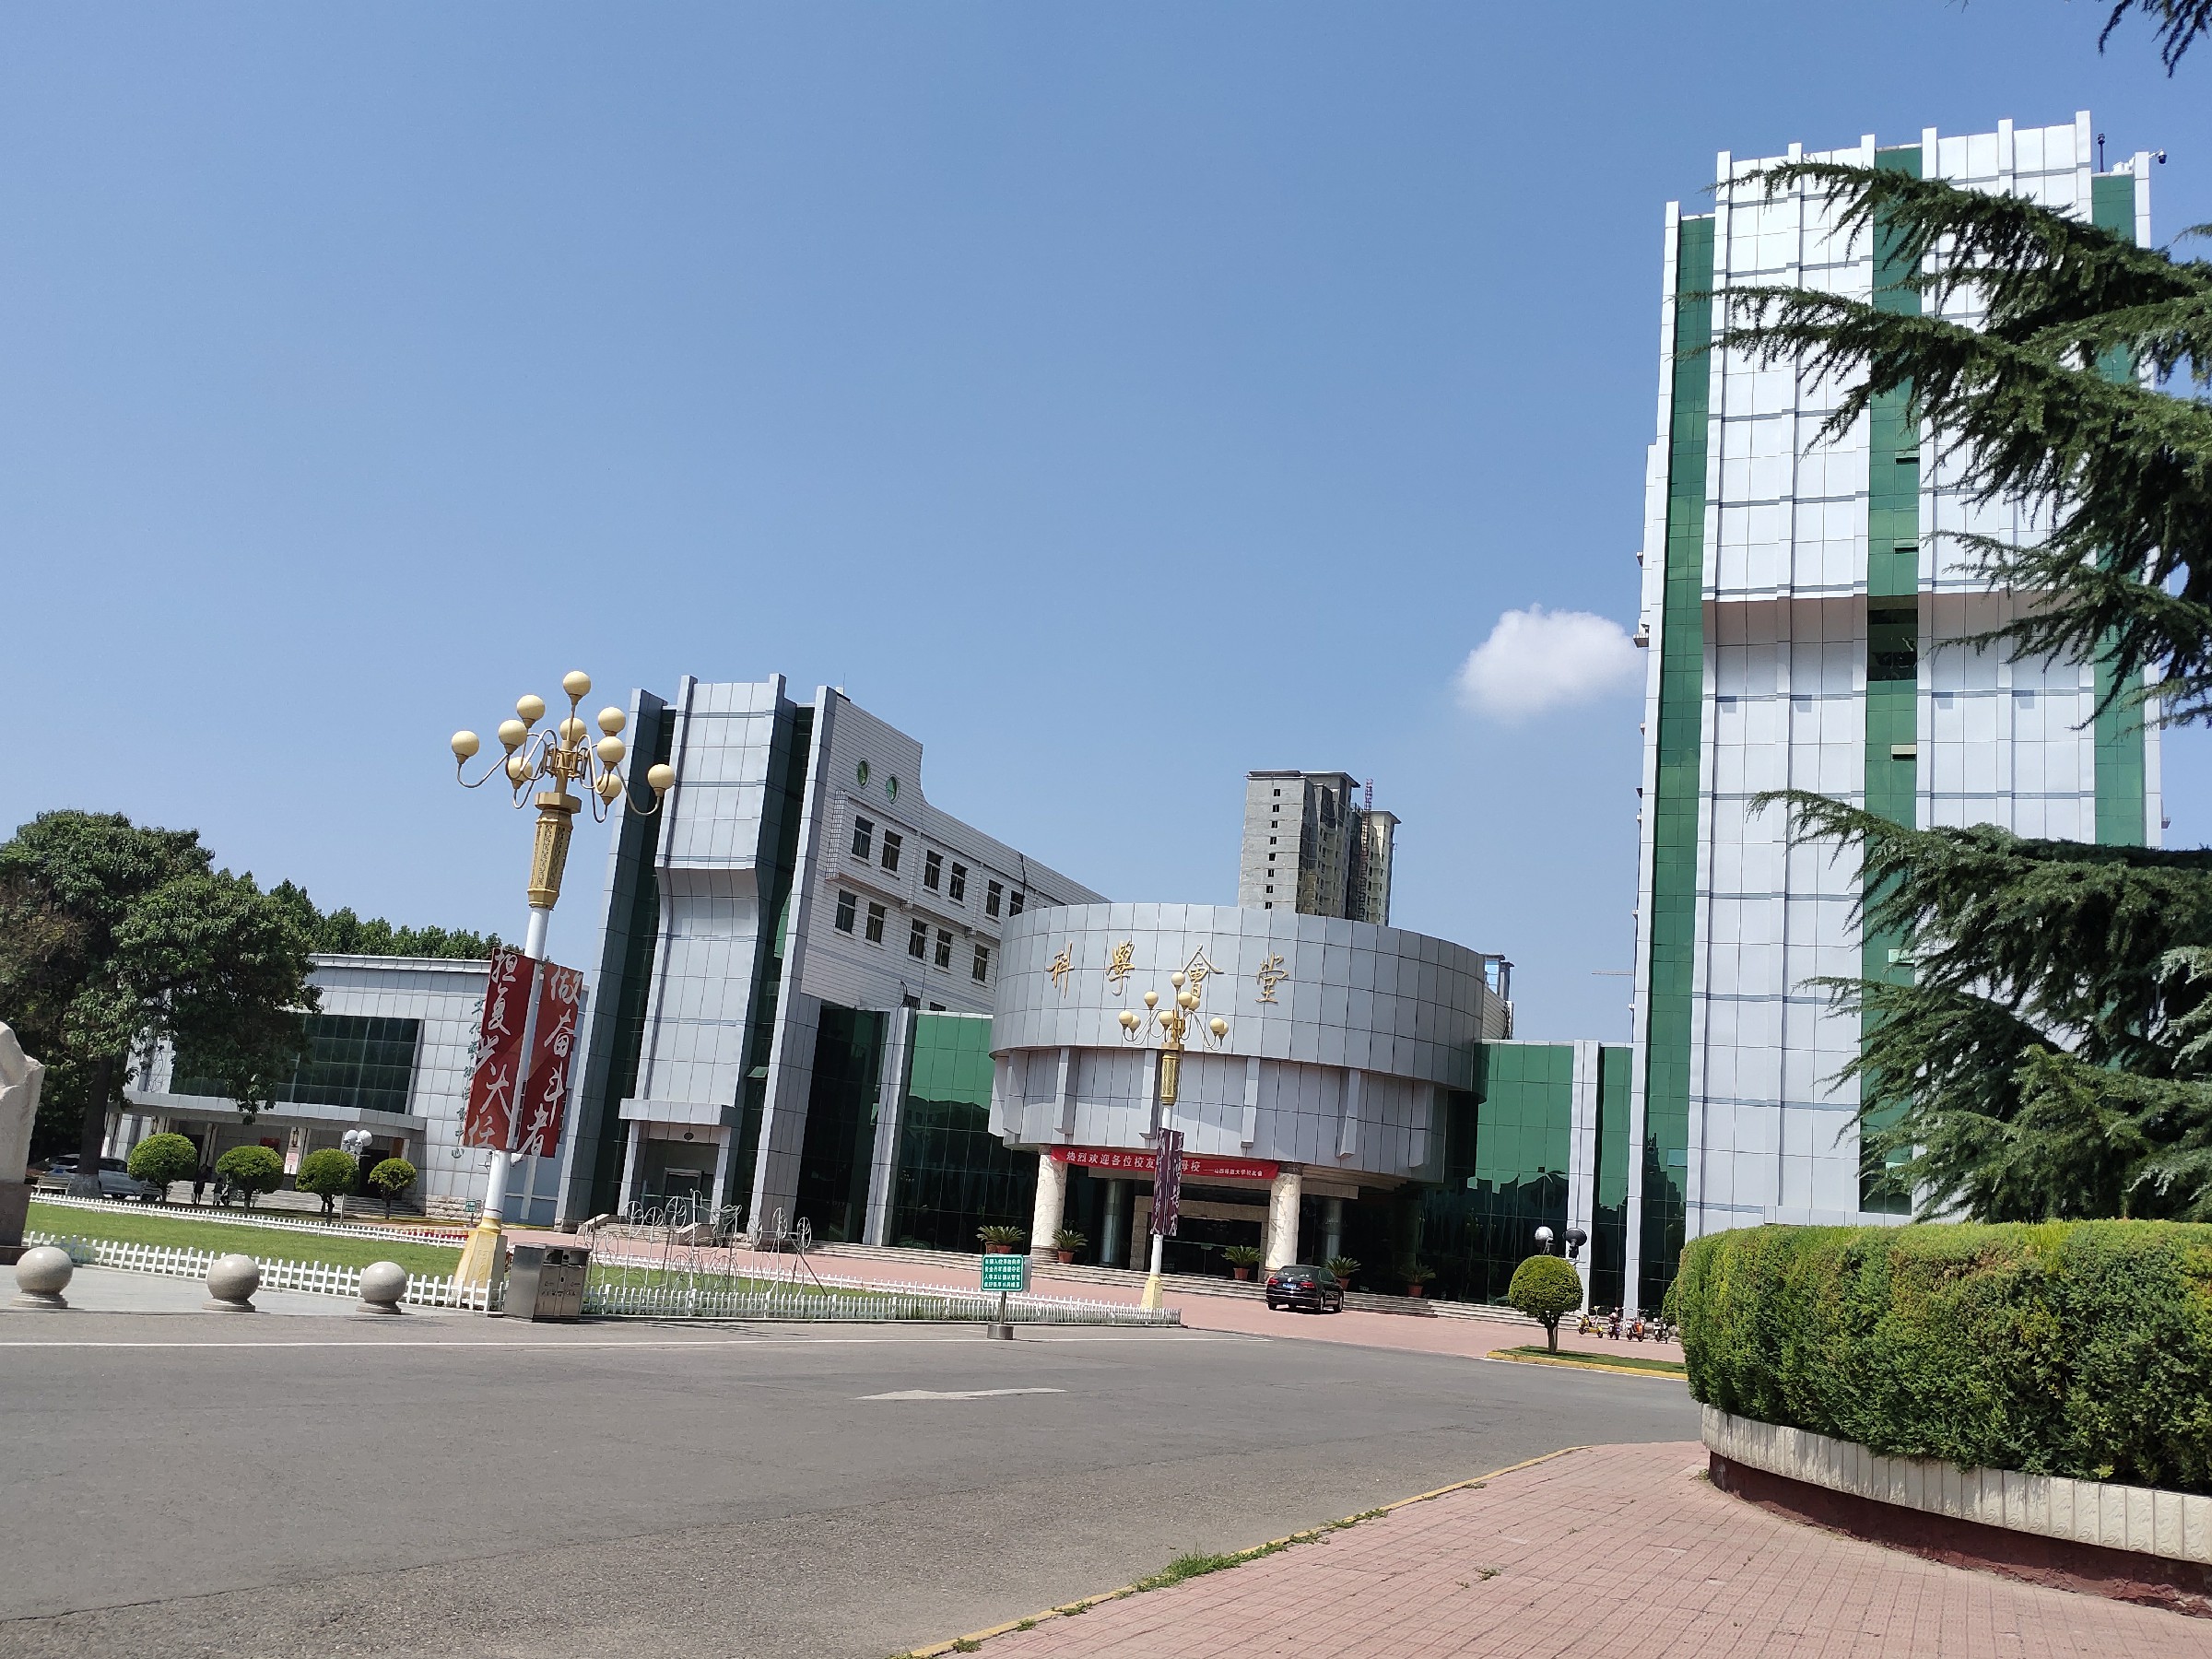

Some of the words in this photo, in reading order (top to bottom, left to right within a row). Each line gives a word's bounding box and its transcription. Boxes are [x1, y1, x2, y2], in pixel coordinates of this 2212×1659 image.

[468, 950, 519, 1149] 担复兴大任
[518, 966, 583, 1156] 做奋斗者
[1066, 1150, 1156, 1169] 热烈欢迎各位校友
